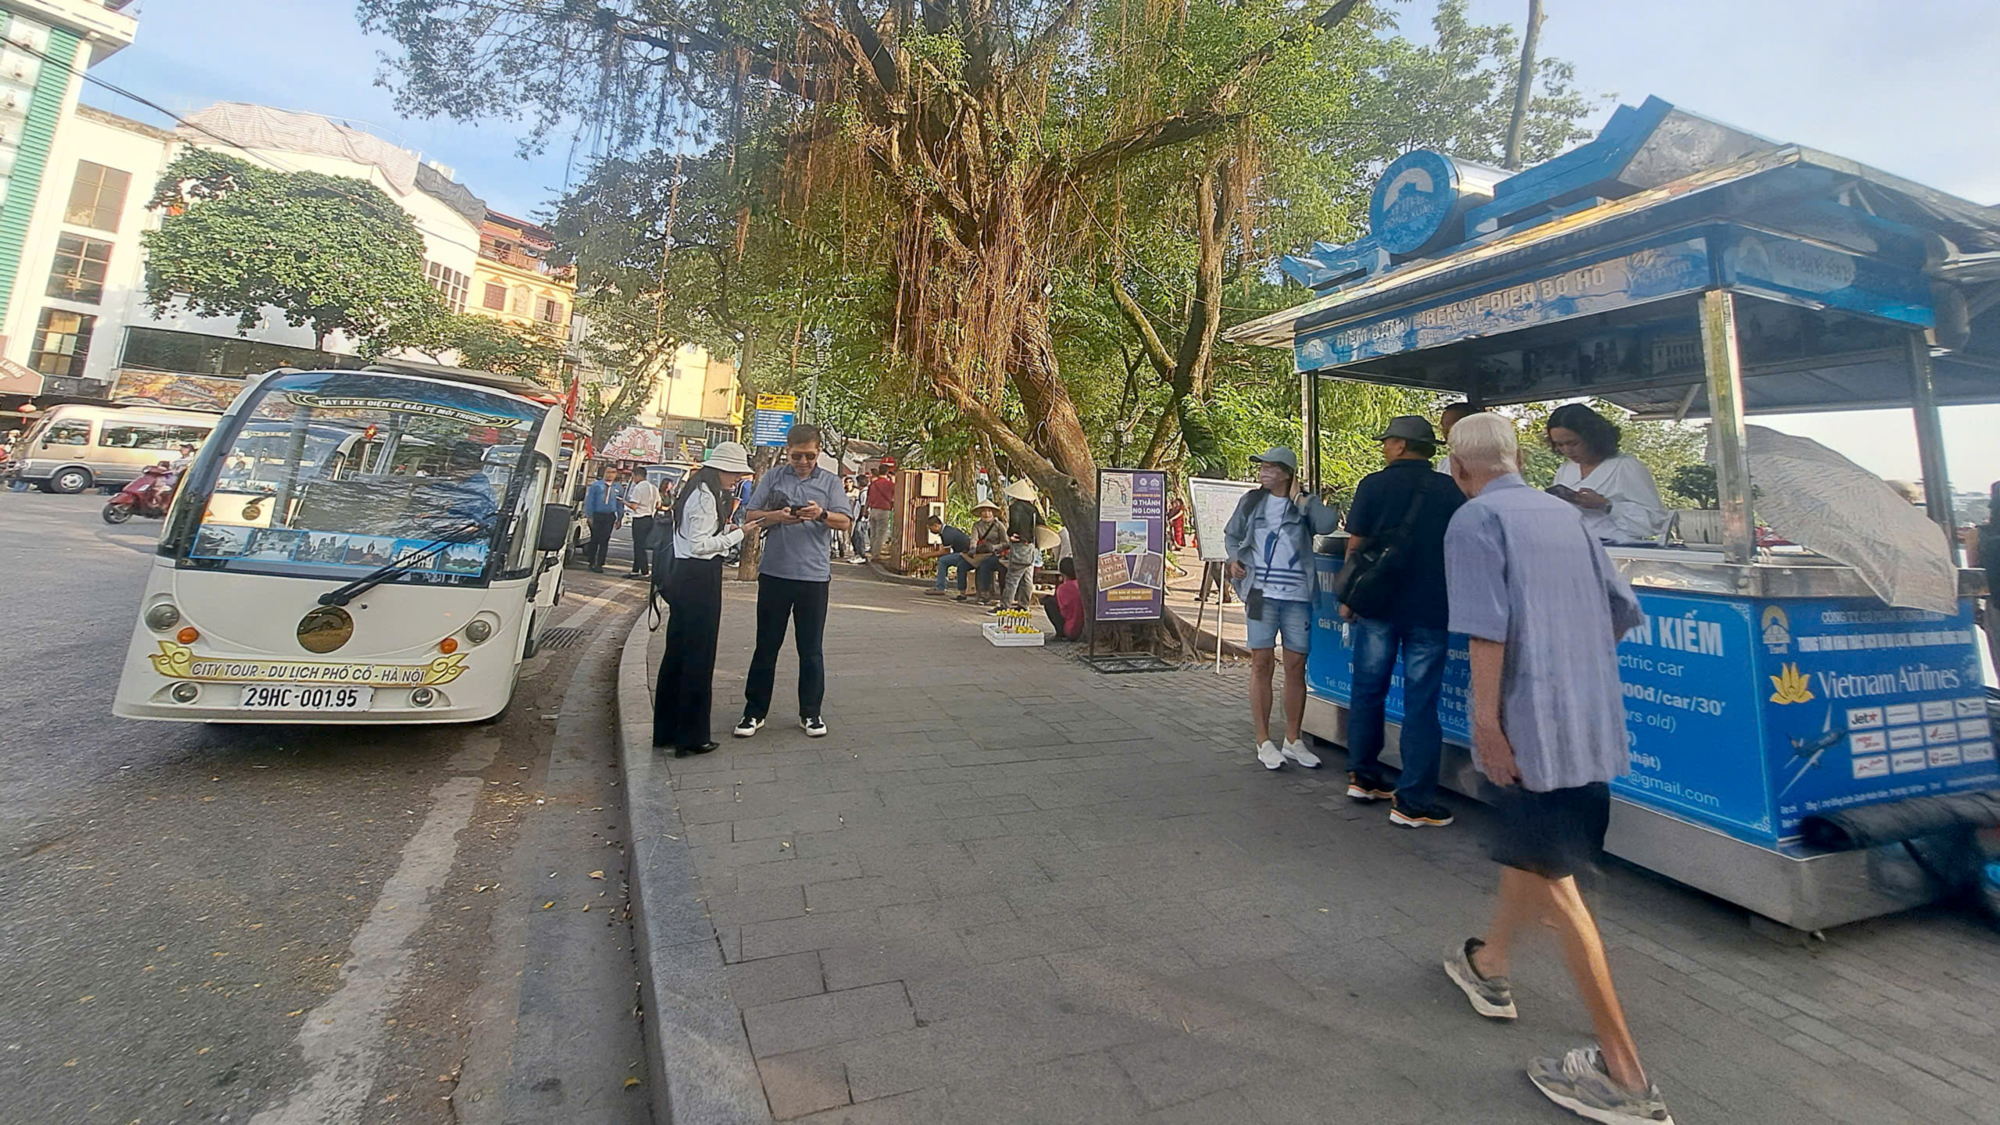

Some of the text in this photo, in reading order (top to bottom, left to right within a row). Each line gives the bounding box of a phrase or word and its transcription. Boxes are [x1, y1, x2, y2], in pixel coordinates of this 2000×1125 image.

[2, 360, 26, 379] LONG
[1658, 609, 1724, 657] KIẾM
[192, 663, 221, 676] CITY
[225, 664, 258, 677] TOUR
[268, 666, 287, 678] DU
[289, 666, 319, 682] LỊCH
[321, 665, 352, 680] PHỐ
[352, 665, 374, 680] CỔ
[382, 667, 398, 681] HÀ
[402, 668, 424, 686] NỘI
[1619, 654, 1684, 677] ctric car
[1817, 663, 1960, 698] Vietnam Airlines
[244, 687, 358, 709] 29HC-001.95
[1647, 714, 1677, 734] old)
[1851, 713, 1869, 725] Jet
[1622, 769, 1719, 808] @gmail.com
